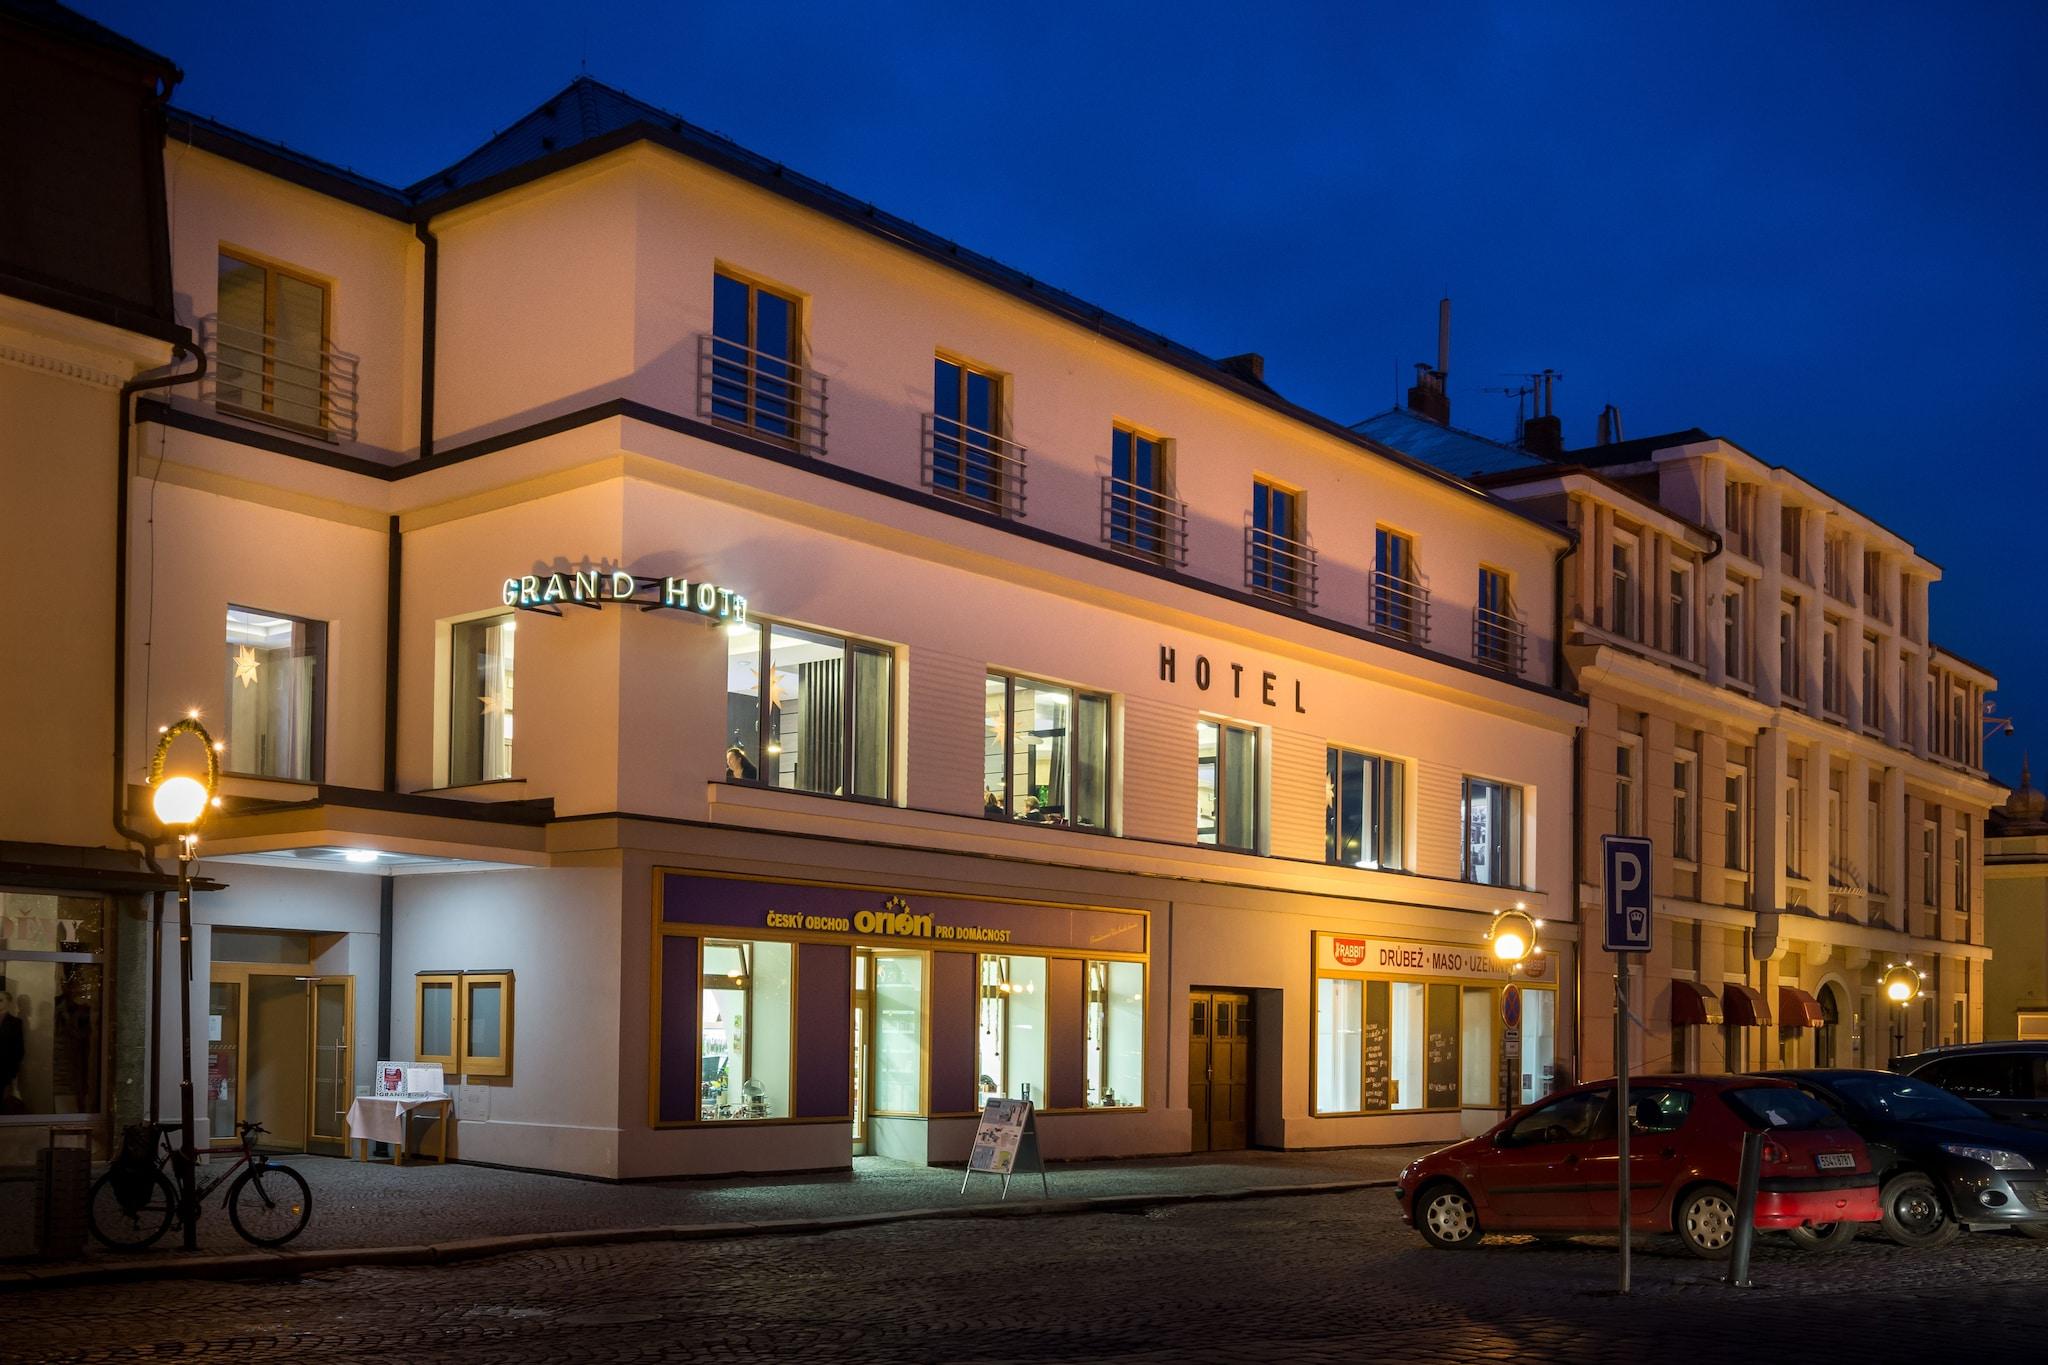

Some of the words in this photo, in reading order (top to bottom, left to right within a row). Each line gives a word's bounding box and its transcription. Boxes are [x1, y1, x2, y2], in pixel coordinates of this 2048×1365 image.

[502, 570, 635, 607] GRAND
[1159, 645, 1307, 714] HOTEL
[1615, 852, 1642, 914] P
[766, 909, 804, 929] ČESKÝ
[805, 914, 849, 932] OBCHOD
[935, 925, 955, 938] PRO
[956, 926, 1012, 943] DOMÁCNOST
[1339, 944, 1364, 958] RABBIT
[1380, 945, 1424, 968] DRŮBEŽ
[1432, 952, 1462, 970] MASO
